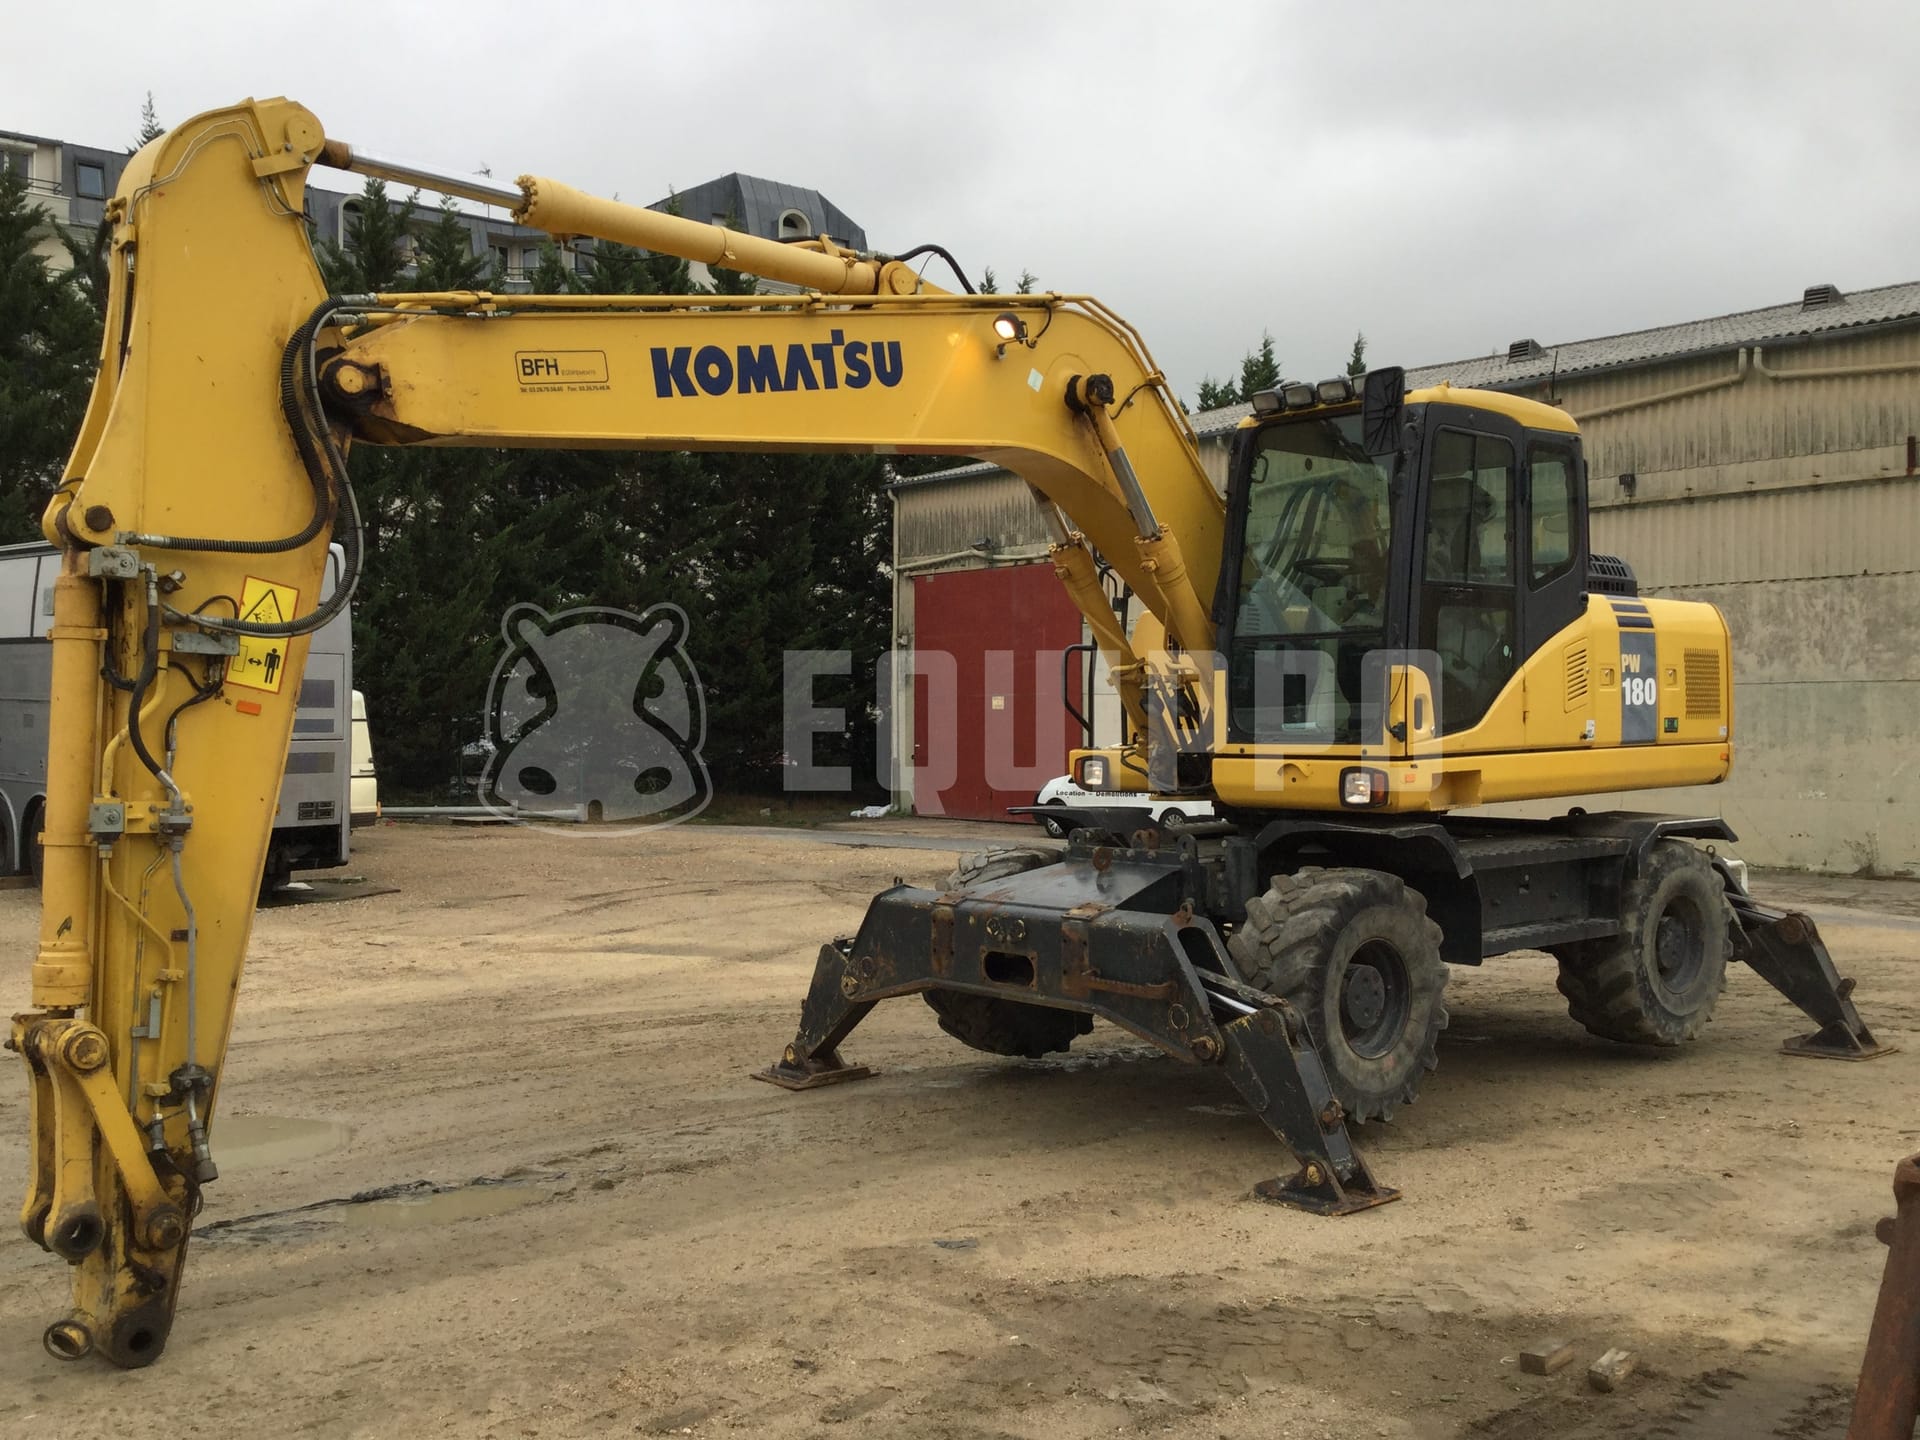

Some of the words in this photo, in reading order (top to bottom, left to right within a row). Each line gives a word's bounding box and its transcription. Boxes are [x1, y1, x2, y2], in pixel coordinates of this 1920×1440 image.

[521, 358, 559, 376] BFH
[650, 329, 904, 398] KOMATSU
[1621, 654, 1641, 672] PW
[1622, 677, 1657, 706] 180
